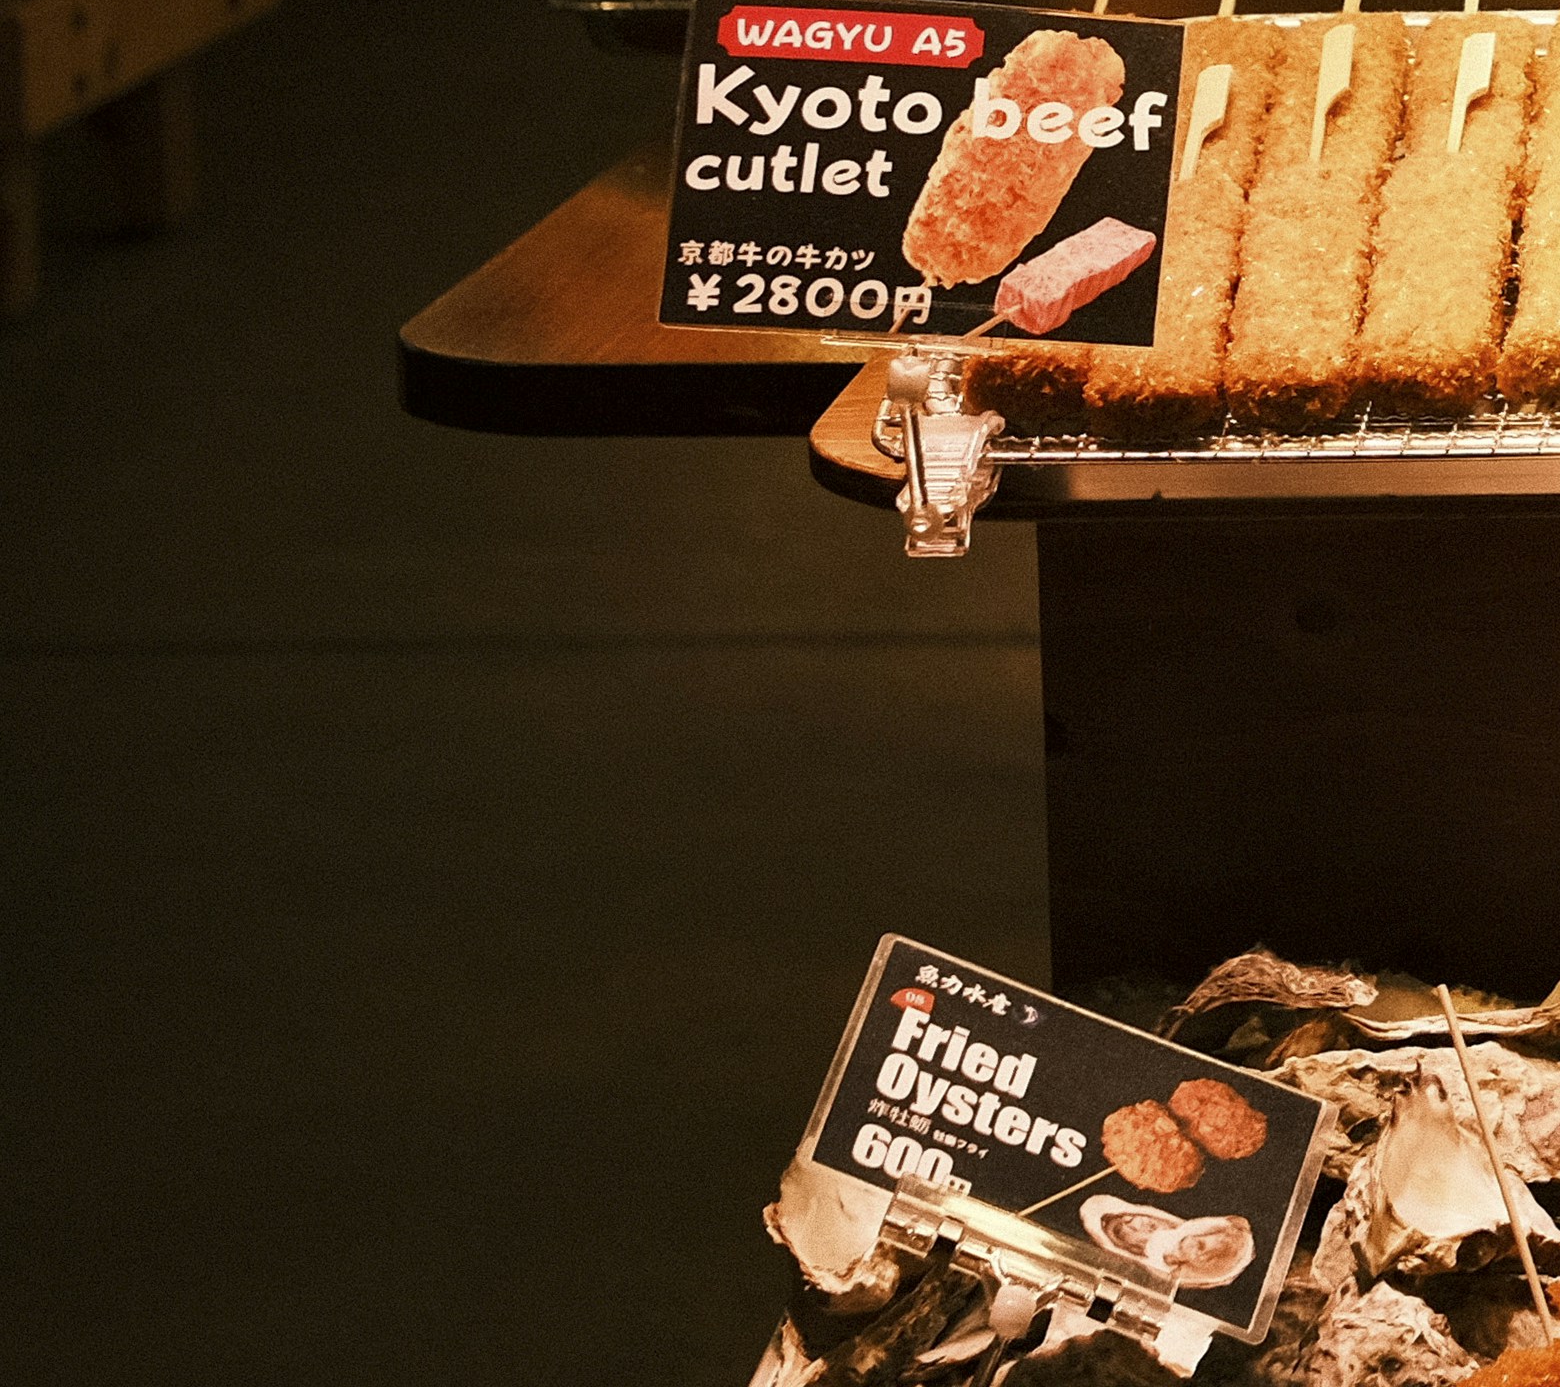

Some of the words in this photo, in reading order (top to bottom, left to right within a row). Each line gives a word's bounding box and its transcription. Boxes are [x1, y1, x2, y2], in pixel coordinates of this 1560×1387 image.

[736, 17, 893, 53] WAGYU
[911, 26, 968, 59] A5
[696, 62, 943, 136] Kyoto
[972, 77, 1169, 151] beef
[685, 142, 894, 199] cutlet
[677, 238, 877, 272] 京都牛の牛カツ
[686, 273, 933, 326] ¥2800円
[891, 1005, 1038, 1099] Fried
[876, 1052, 1088, 1168] Oysters
